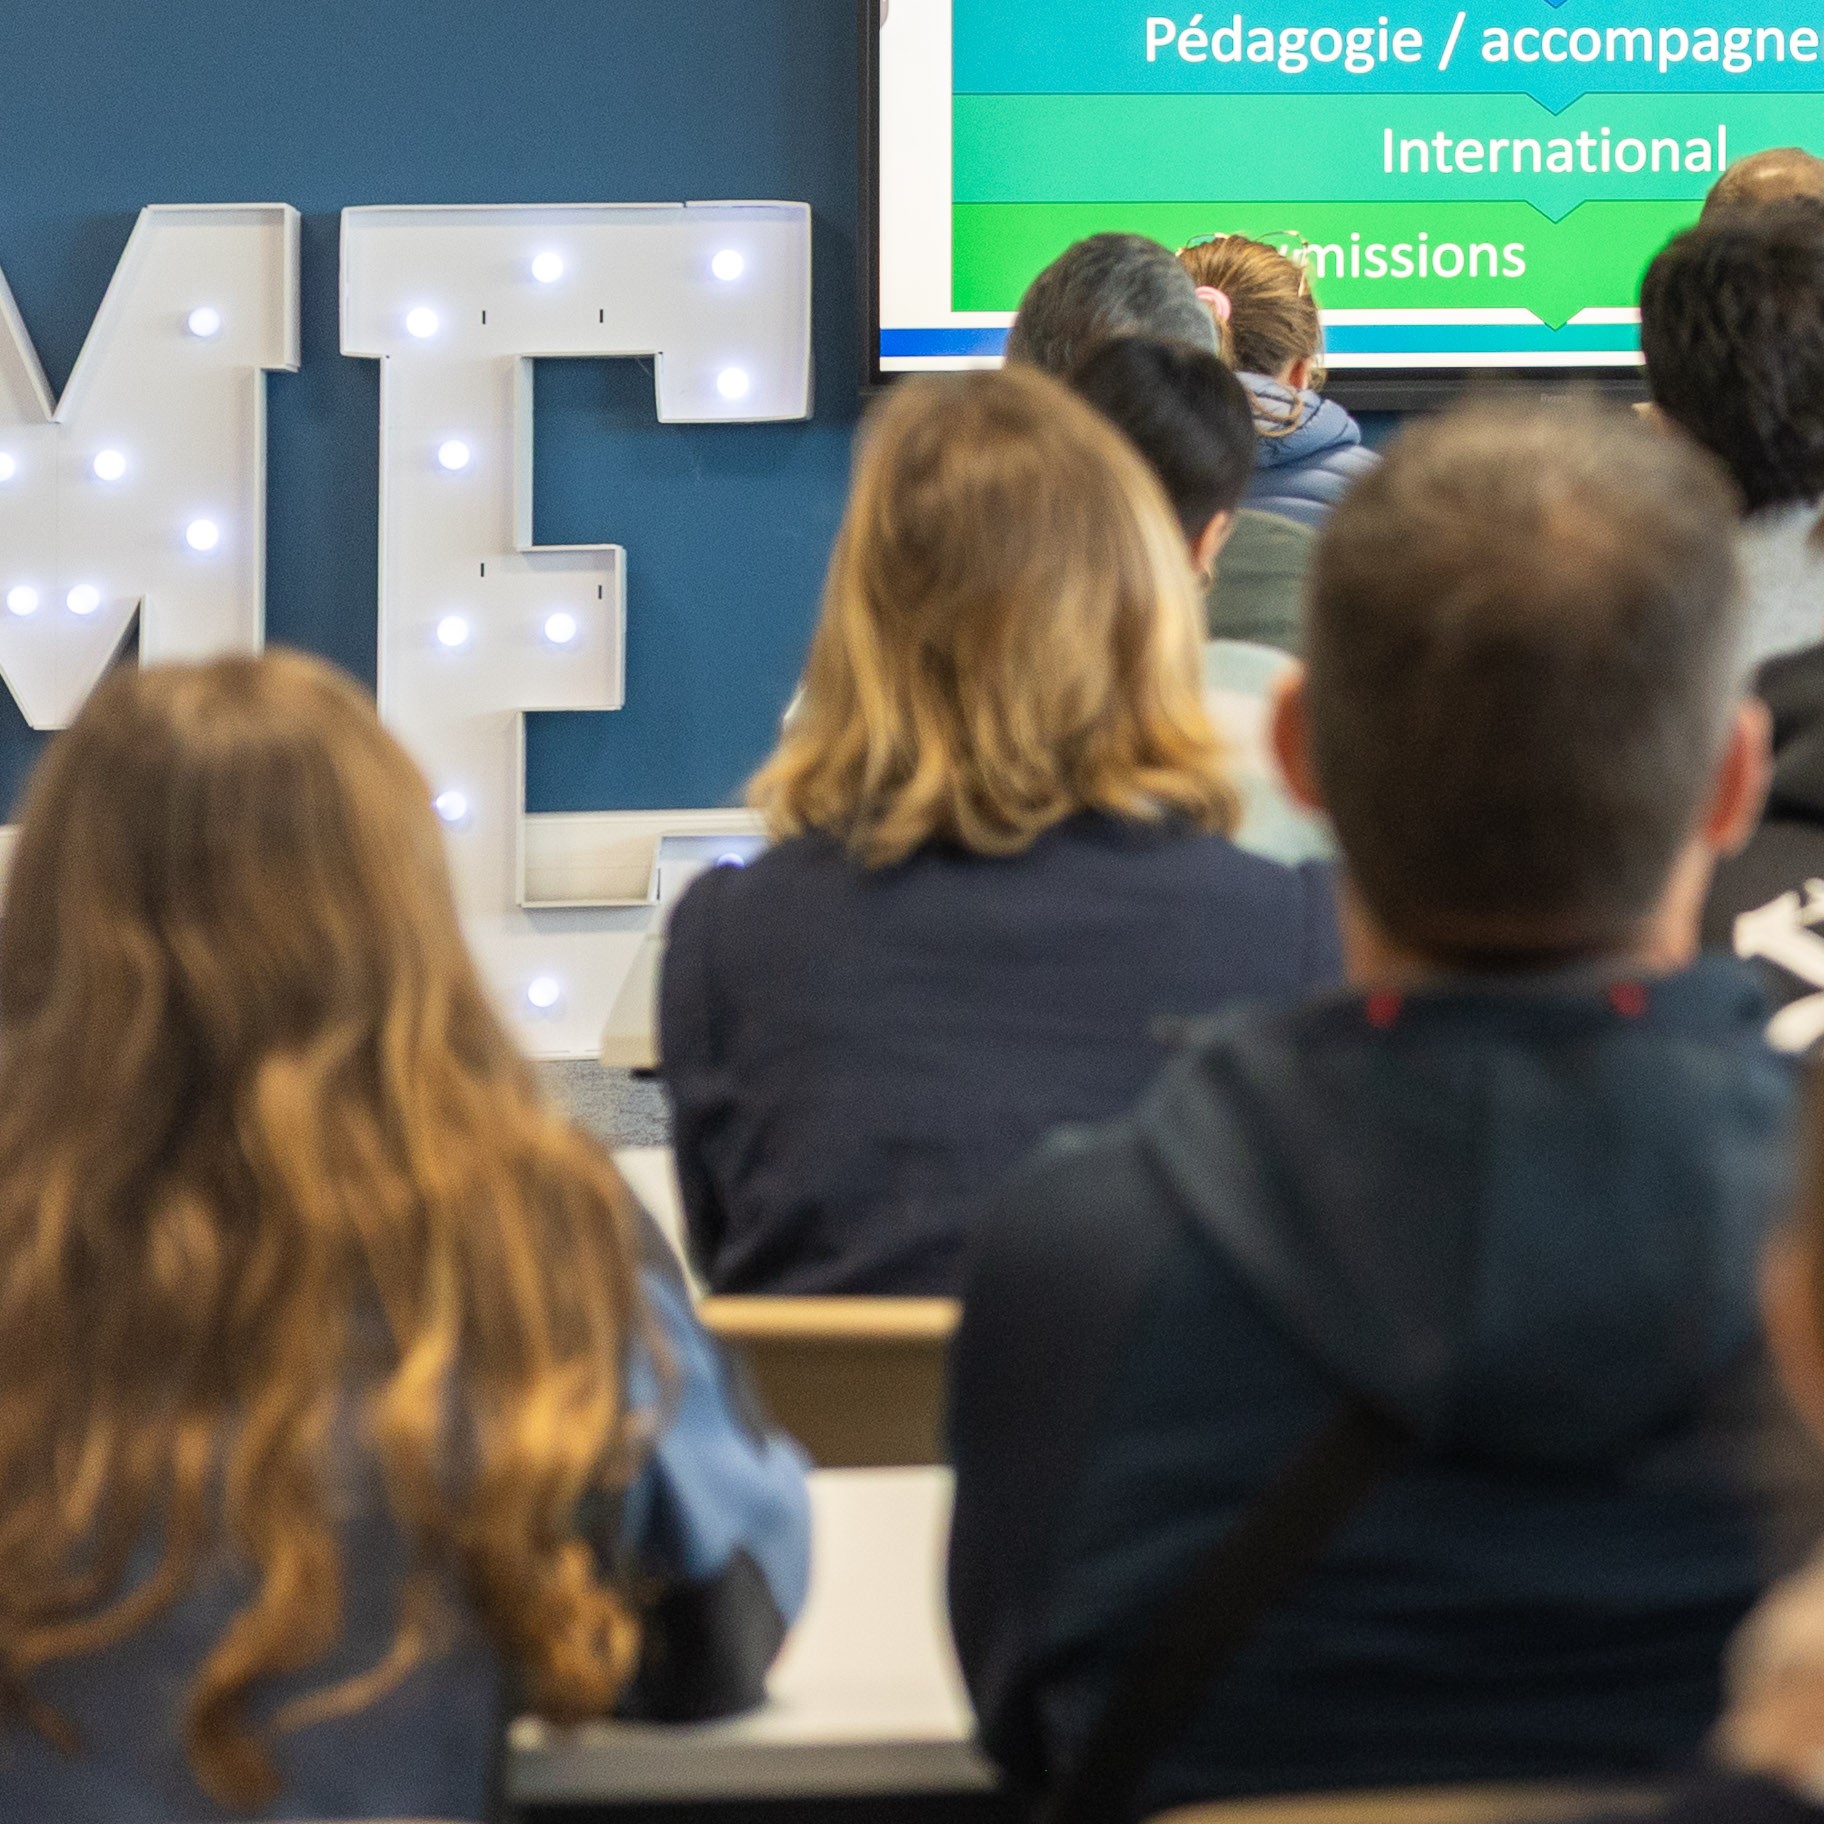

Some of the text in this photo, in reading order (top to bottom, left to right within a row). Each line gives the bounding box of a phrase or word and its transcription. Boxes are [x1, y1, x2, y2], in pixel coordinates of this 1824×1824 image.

[1146, 12, 1423, 74] Pédagogie
[1438, 11, 1466, 71] /
[1383, 124, 1728, 174] International
